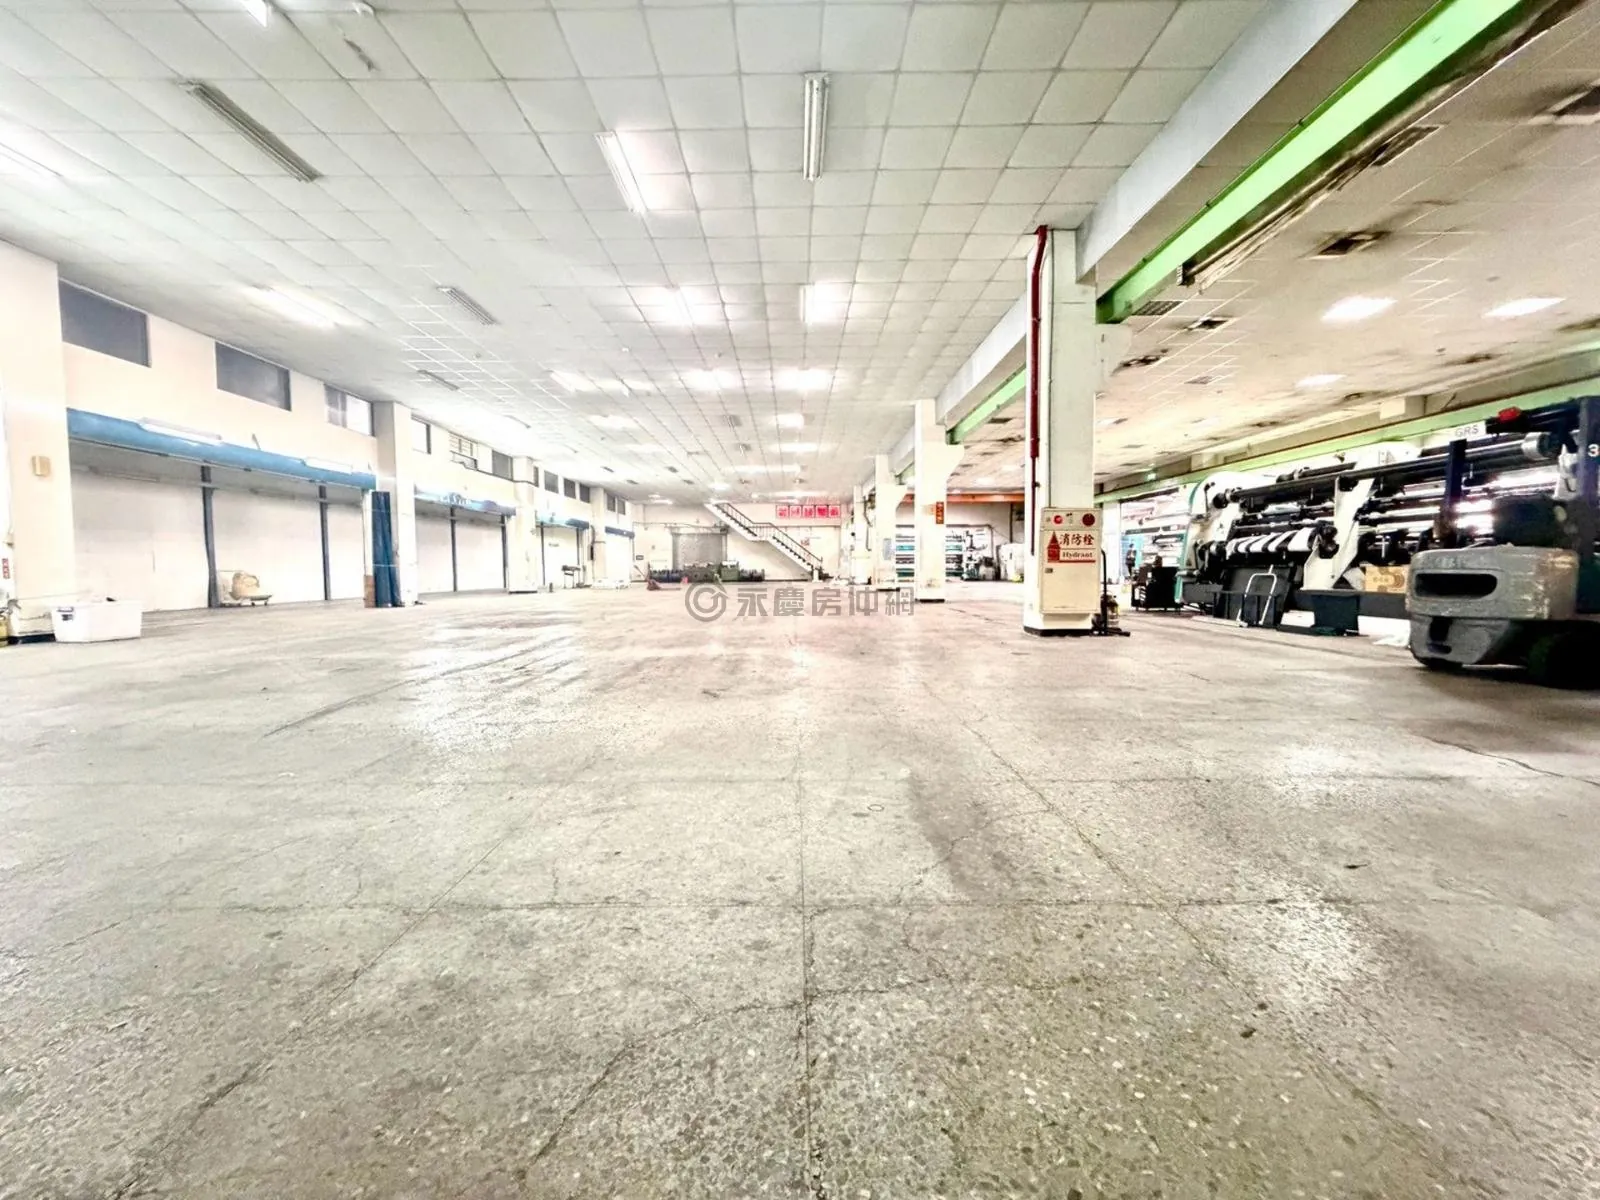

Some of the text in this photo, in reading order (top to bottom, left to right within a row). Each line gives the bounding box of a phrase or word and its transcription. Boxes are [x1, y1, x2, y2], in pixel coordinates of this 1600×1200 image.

[1060, 533, 1094, 546] 消防栓
[1062, 551, 1093, 559] Hydrant
